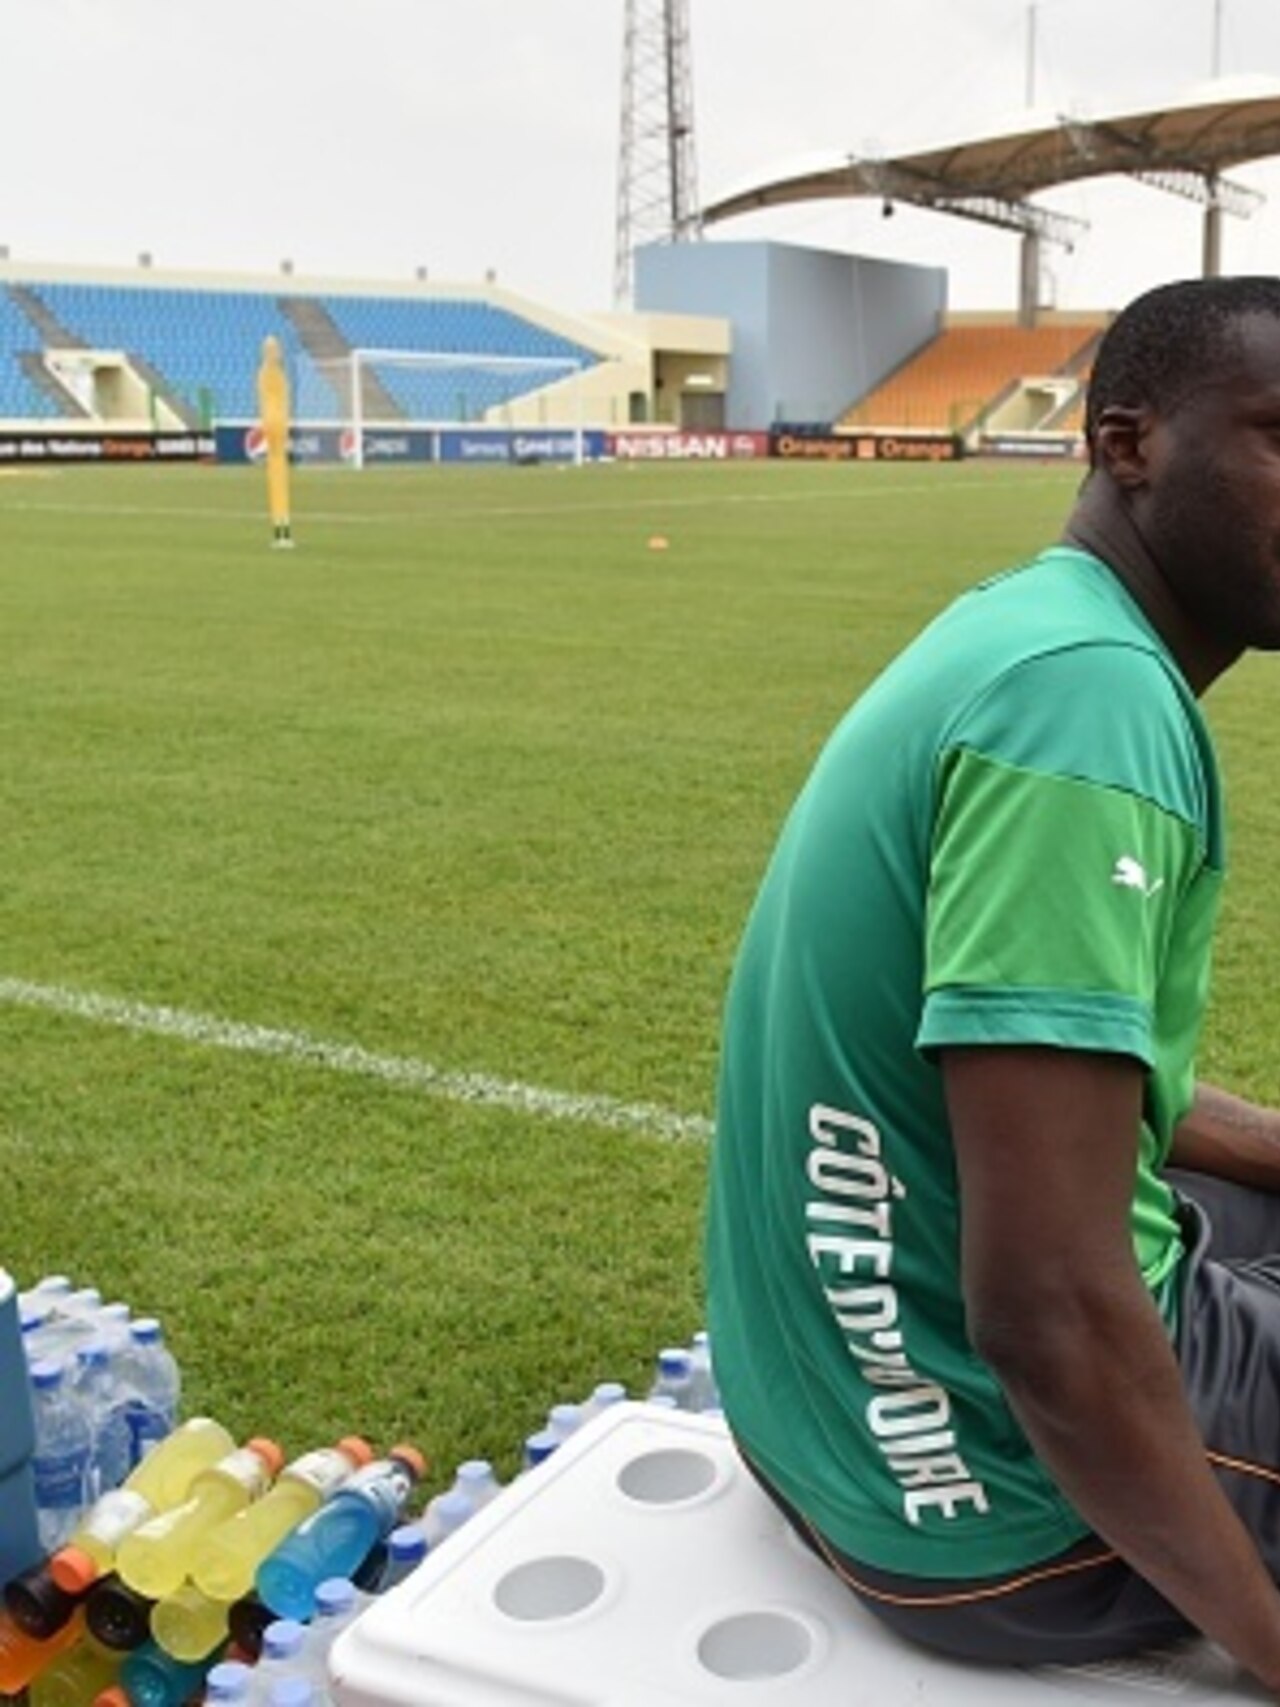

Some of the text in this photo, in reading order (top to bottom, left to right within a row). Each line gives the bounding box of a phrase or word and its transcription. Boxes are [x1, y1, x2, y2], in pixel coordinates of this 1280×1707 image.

[616, 435, 726, 458] NISSAN
[777, 436, 851, 460] Orange
[880, 437, 953, 461] Orange
[806, 1102, 906, 1276] CÔTE
